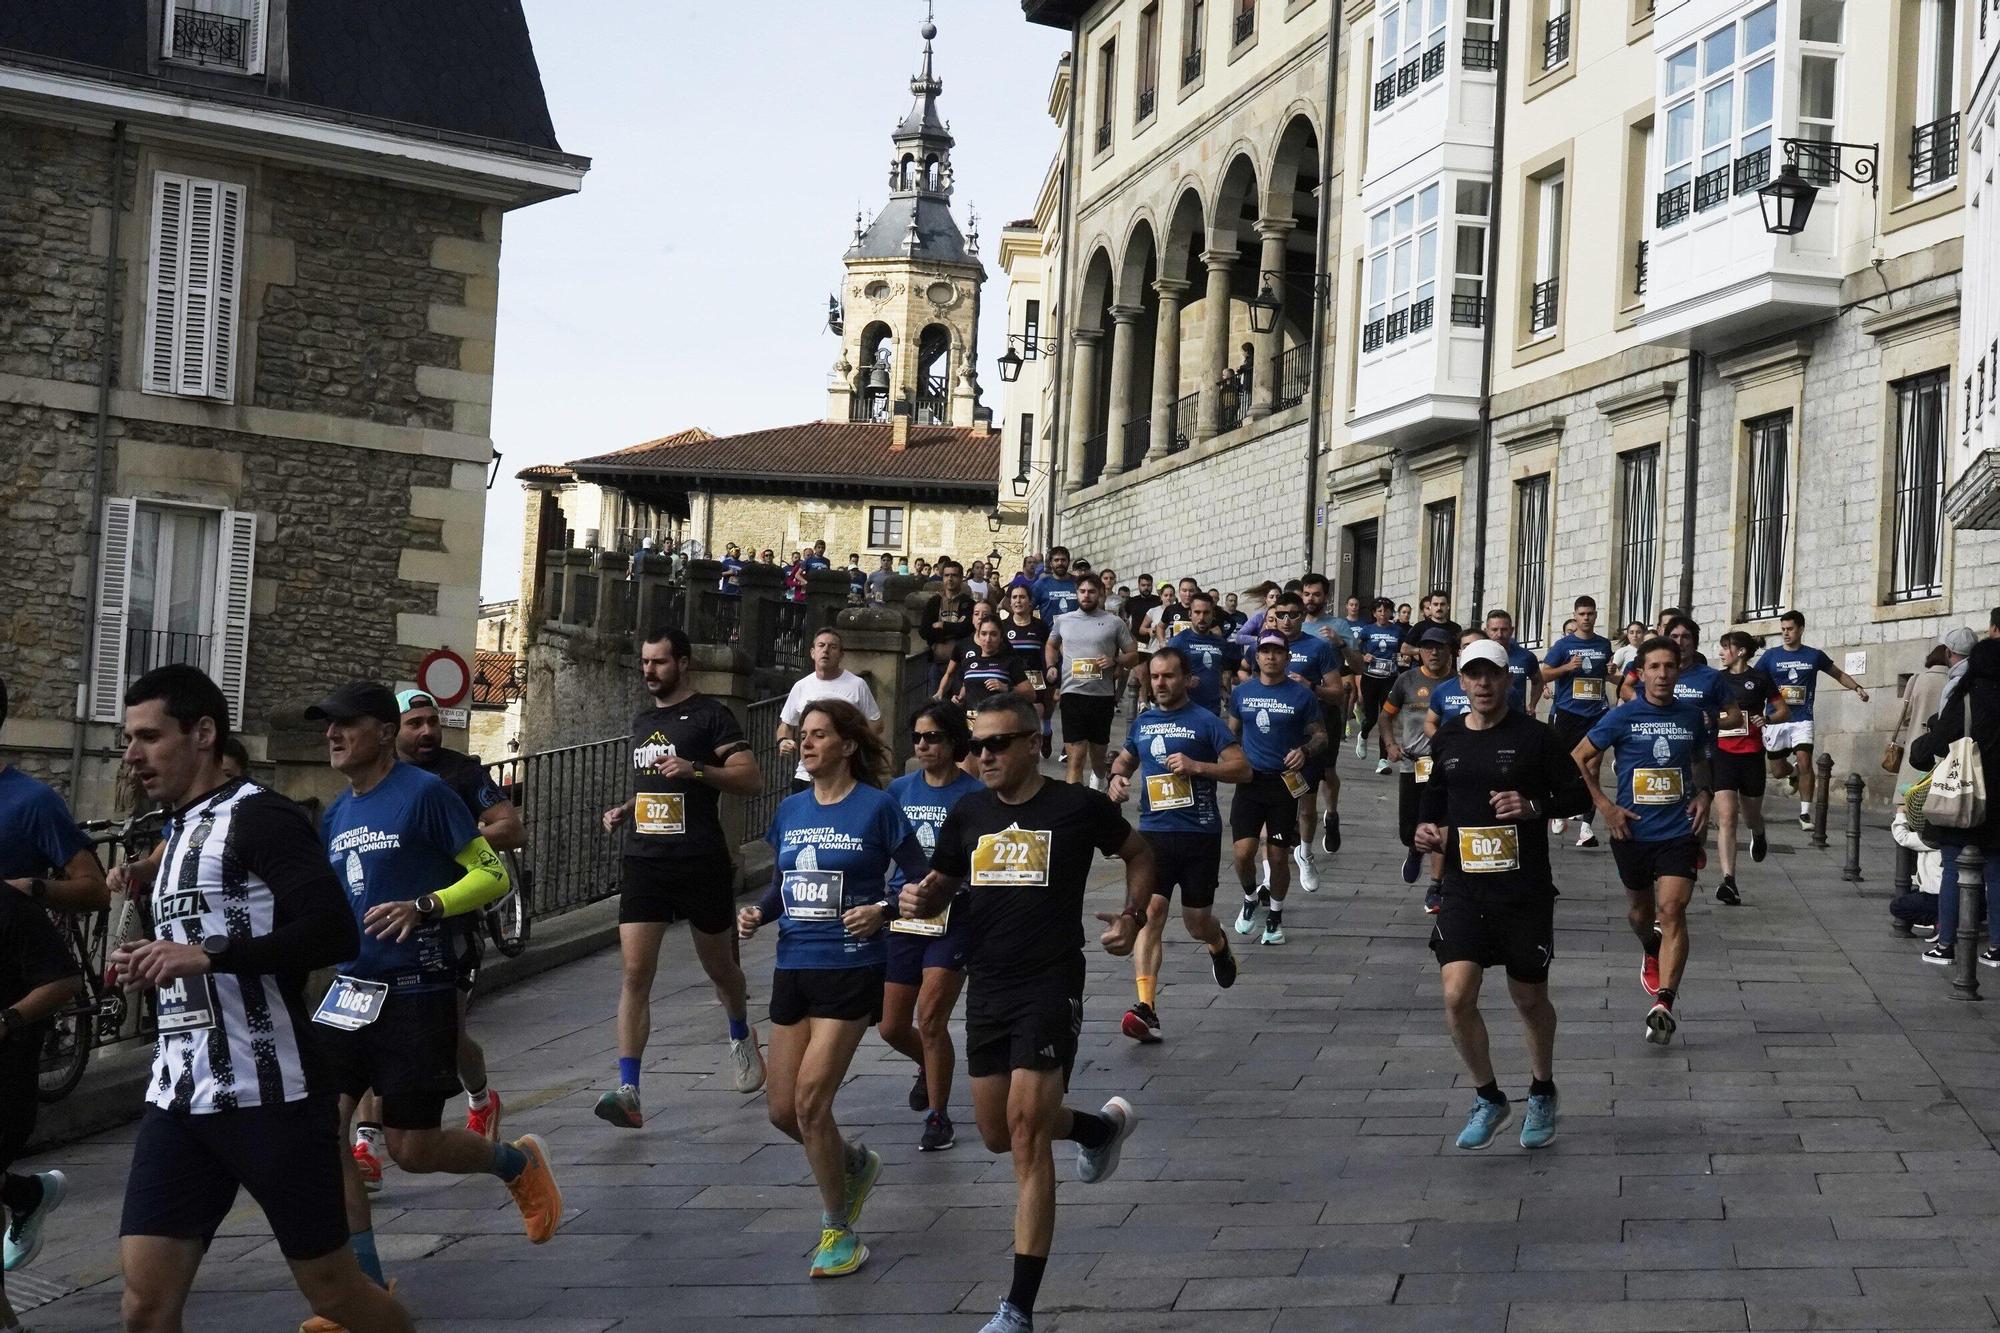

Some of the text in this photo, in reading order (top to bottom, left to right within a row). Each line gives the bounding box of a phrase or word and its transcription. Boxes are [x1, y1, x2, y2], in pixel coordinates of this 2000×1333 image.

[1248, 701, 1287, 709] ALMENDRA
[1145, 726, 1187, 735] ALMENDRA
[1642, 727, 1688, 735] ALMENDRA
[1161, 782, 1174, 796] 41
[1646, 777, 1671, 791] 245
[647, 803, 669, 819] 372
[906, 812, 948, 822] ALMEND
[790, 826, 835, 837] CONQUISTA
[334, 830, 386, 853] ALMENDRA
[789, 833, 851, 845] ALMENDRA
[358, 839, 401, 854] KONKISTA
[818, 842, 864, 852] KONKISTA
[993, 842, 1029, 864] 222
[1471, 838, 1502, 856] 602
[791, 882, 829, 902] 1084
[335, 989, 373, 1013] 1083
